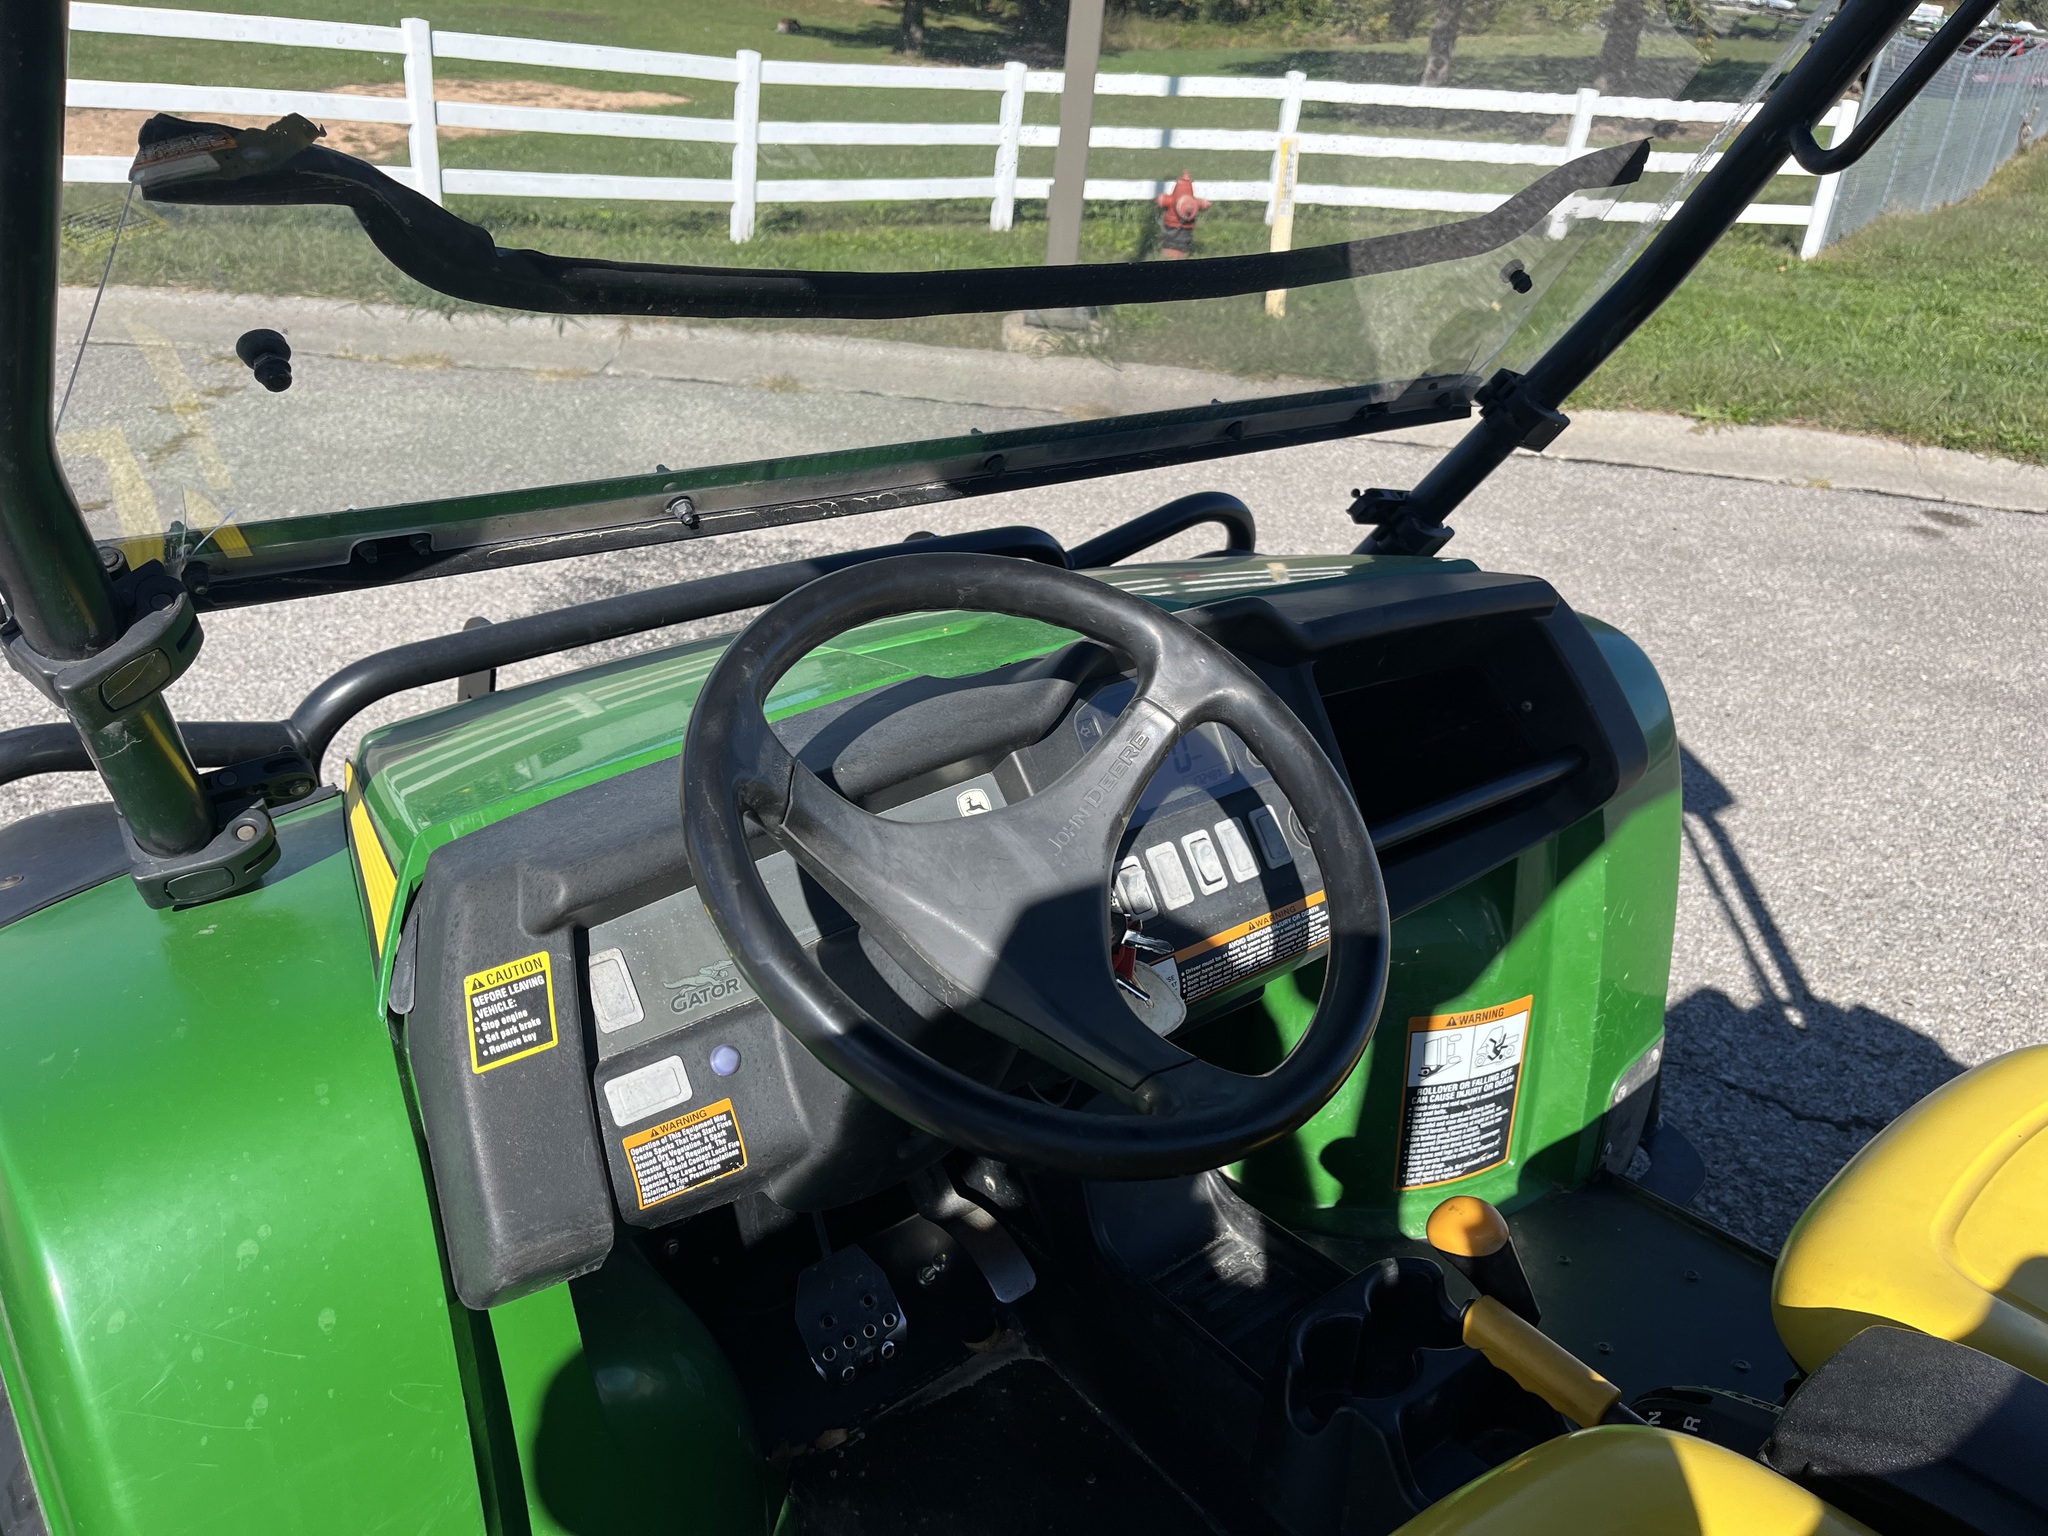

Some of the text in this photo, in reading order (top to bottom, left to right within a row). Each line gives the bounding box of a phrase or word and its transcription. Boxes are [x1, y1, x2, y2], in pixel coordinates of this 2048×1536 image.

[1048, 730, 1149, 857] JOHN DEERE
[1229, 937, 1246, 949] AVOID
[1246, 926, 1272, 941] SERIOUS
[1272, 918, 1291, 931] INJURY
[1301, 905, 1319, 918] DEATH
[1257, 905, 1296, 927] WARNING
[486, 957, 543, 985] CAUTION
[472, 975, 545, 1007] BEFORE LEAVING
[670, 977, 742, 1014] GATOR
[476, 998, 517, 1020] VEHICLE:
[481, 1010, 528, 1031] Stop engine
[1459, 1008, 1504, 1024] WARNING
[485, 1018, 541, 1043] Set park brake
[489, 1038, 522, 1055] Remove
[522, 1032, 537, 1043] key
[1411, 1074, 1515, 1106] CAN CAUSE INJURY OR DEATH
[1418, 1068, 1513, 1099] ROLLOVER OR FALLING OFF
[630, 1114, 726, 1157] Operation of This Equipment May
[660, 1110, 707, 1133] WARNING
[633, 1120, 732, 1163] Create Sparks That Can Start Fires
[635, 1157, 657, 1171] Around
[657, 1153, 669, 1162] Dry
[669, 1140, 703, 1157] Vegetation.
[709, 1130, 727, 1141] Spark
[638, 1164, 661, 1178] Arrestor
[662, 1158, 676, 1168] May
[685, 1143, 714, 1159] Required.
[714, 1138, 726, 1147] The
[639, 1141, 740, 1185] Operator Should Contact Local Fire
[642, 1177, 669, 1192] Agencies
[669, 1173, 679, 1181] For
[680, 1166, 697, 1177] Laws
[705, 1149, 739, 1167] Regulations
[642, 1185, 668, 1201] Relating
[676, 1177, 688, 1186] Fire
[689, 1164, 721, 1180] Prevention
[1648, 1411, 1661, 1425] N
[1683, 1416, 1701, 1432] R
